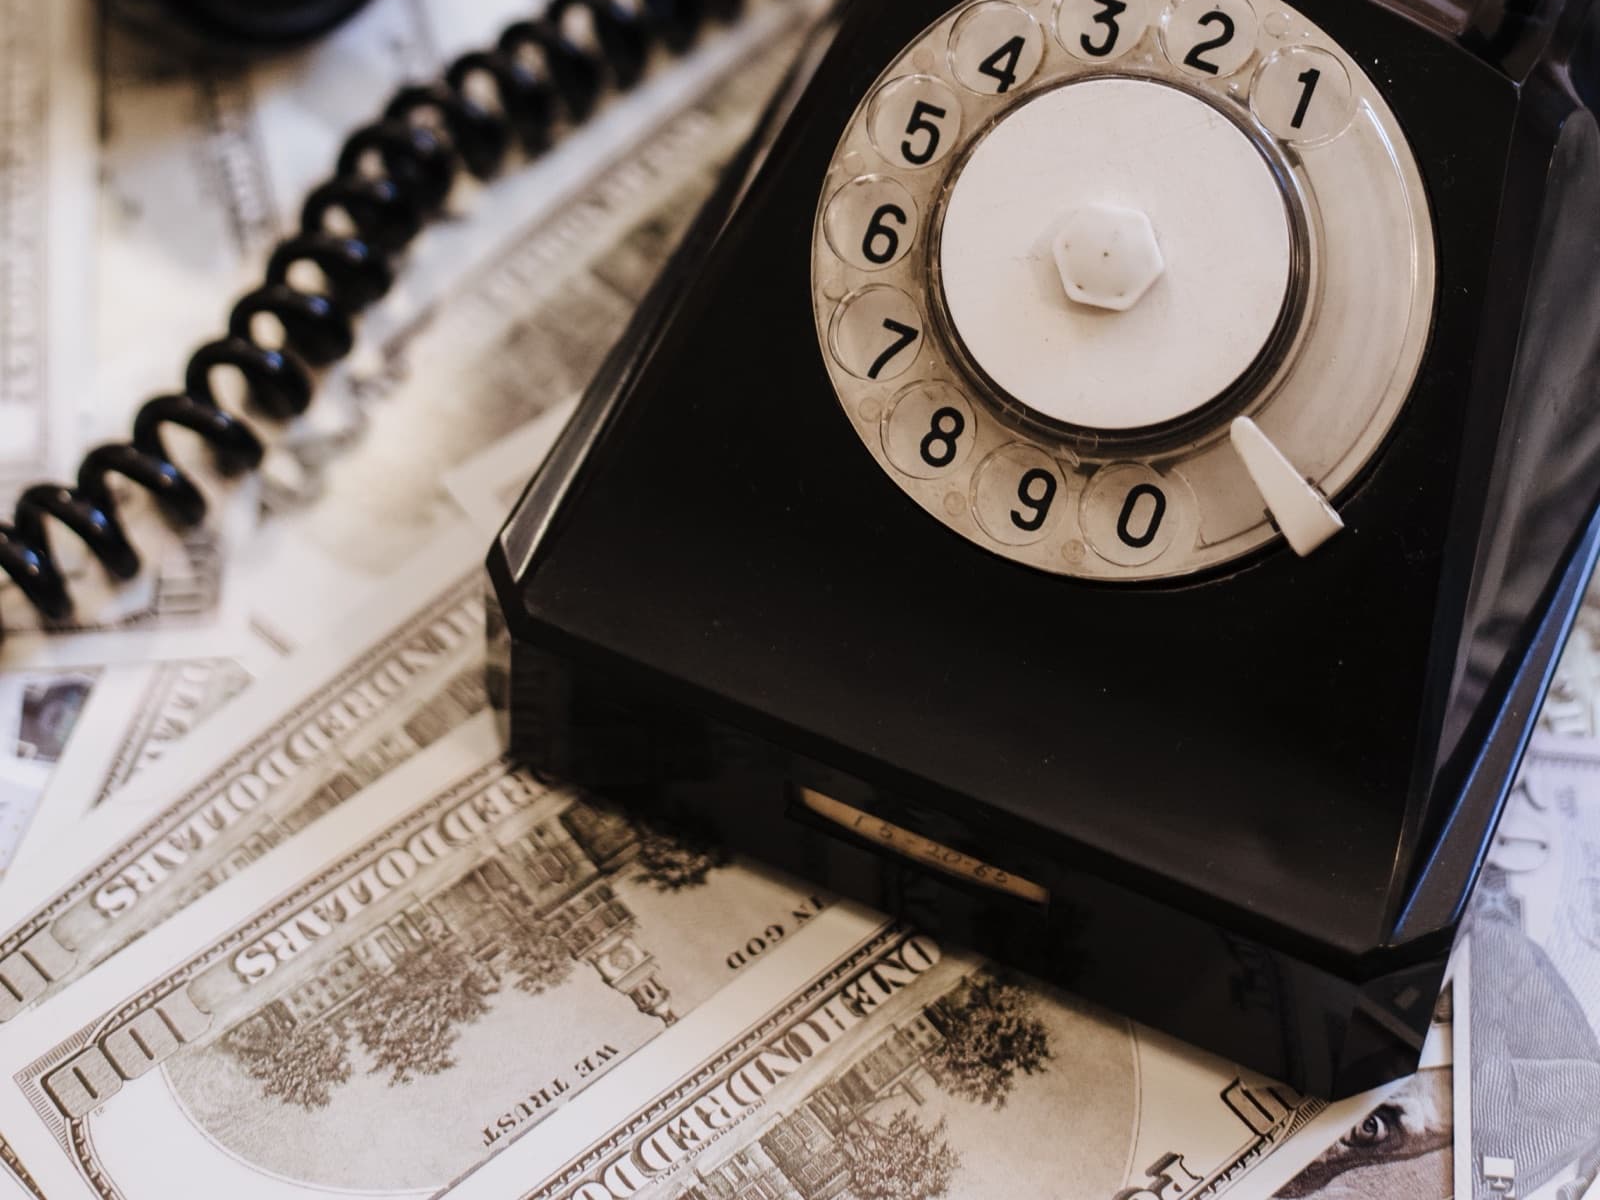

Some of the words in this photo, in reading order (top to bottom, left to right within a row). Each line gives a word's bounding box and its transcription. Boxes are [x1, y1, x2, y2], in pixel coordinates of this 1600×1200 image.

[978, 36, 1026, 94] 4
[1183, 10, 1235, 75] 2
[1290, 68, 1321, 129] 1
[901, 100, 947, 165] 5
[862, 203, 907, 265] 6
[867, 318, 919, 380] 7
[919, 406, 965, 468] 8
[1010, 467, 1058, 532] 9
[1116, 482, 1167, 549] 0
[90, 750, 297, 920] DOLLARS
[229, 825, 452, 986] DOLLARS
[790, 894, 825, 925] IN
[723, 921, 786, 972] GOD
[841, 934, 944, 1018] ONE
[40, 980, 217, 1121] 100
[573, 1040, 619, 1078] WE
[477, 1075, 569, 1146] TRUST
[633, 996, 855, 1174] HUNDRED
[682, 1097, 766, 1163] INDEPENDENCE
[651, 1162, 680, 1185] HALL
